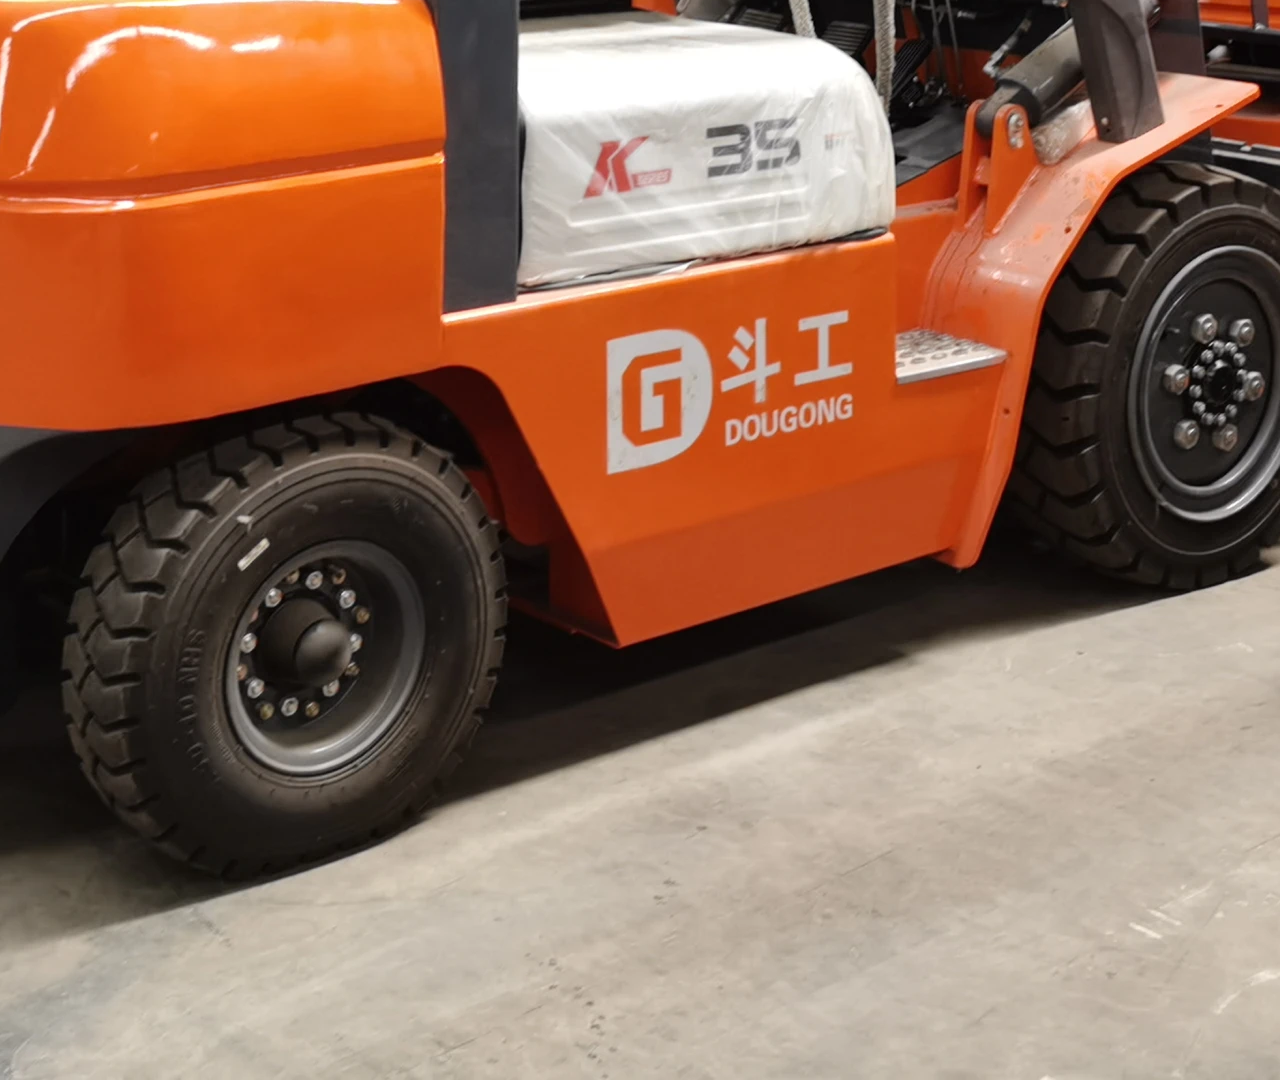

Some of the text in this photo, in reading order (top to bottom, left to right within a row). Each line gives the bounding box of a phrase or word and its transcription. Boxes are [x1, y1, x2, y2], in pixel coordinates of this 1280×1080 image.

[705, 116, 802, 179] 35
[721, 309, 853, 404] 斗工
[725, 393, 853, 447] DOUGONG
